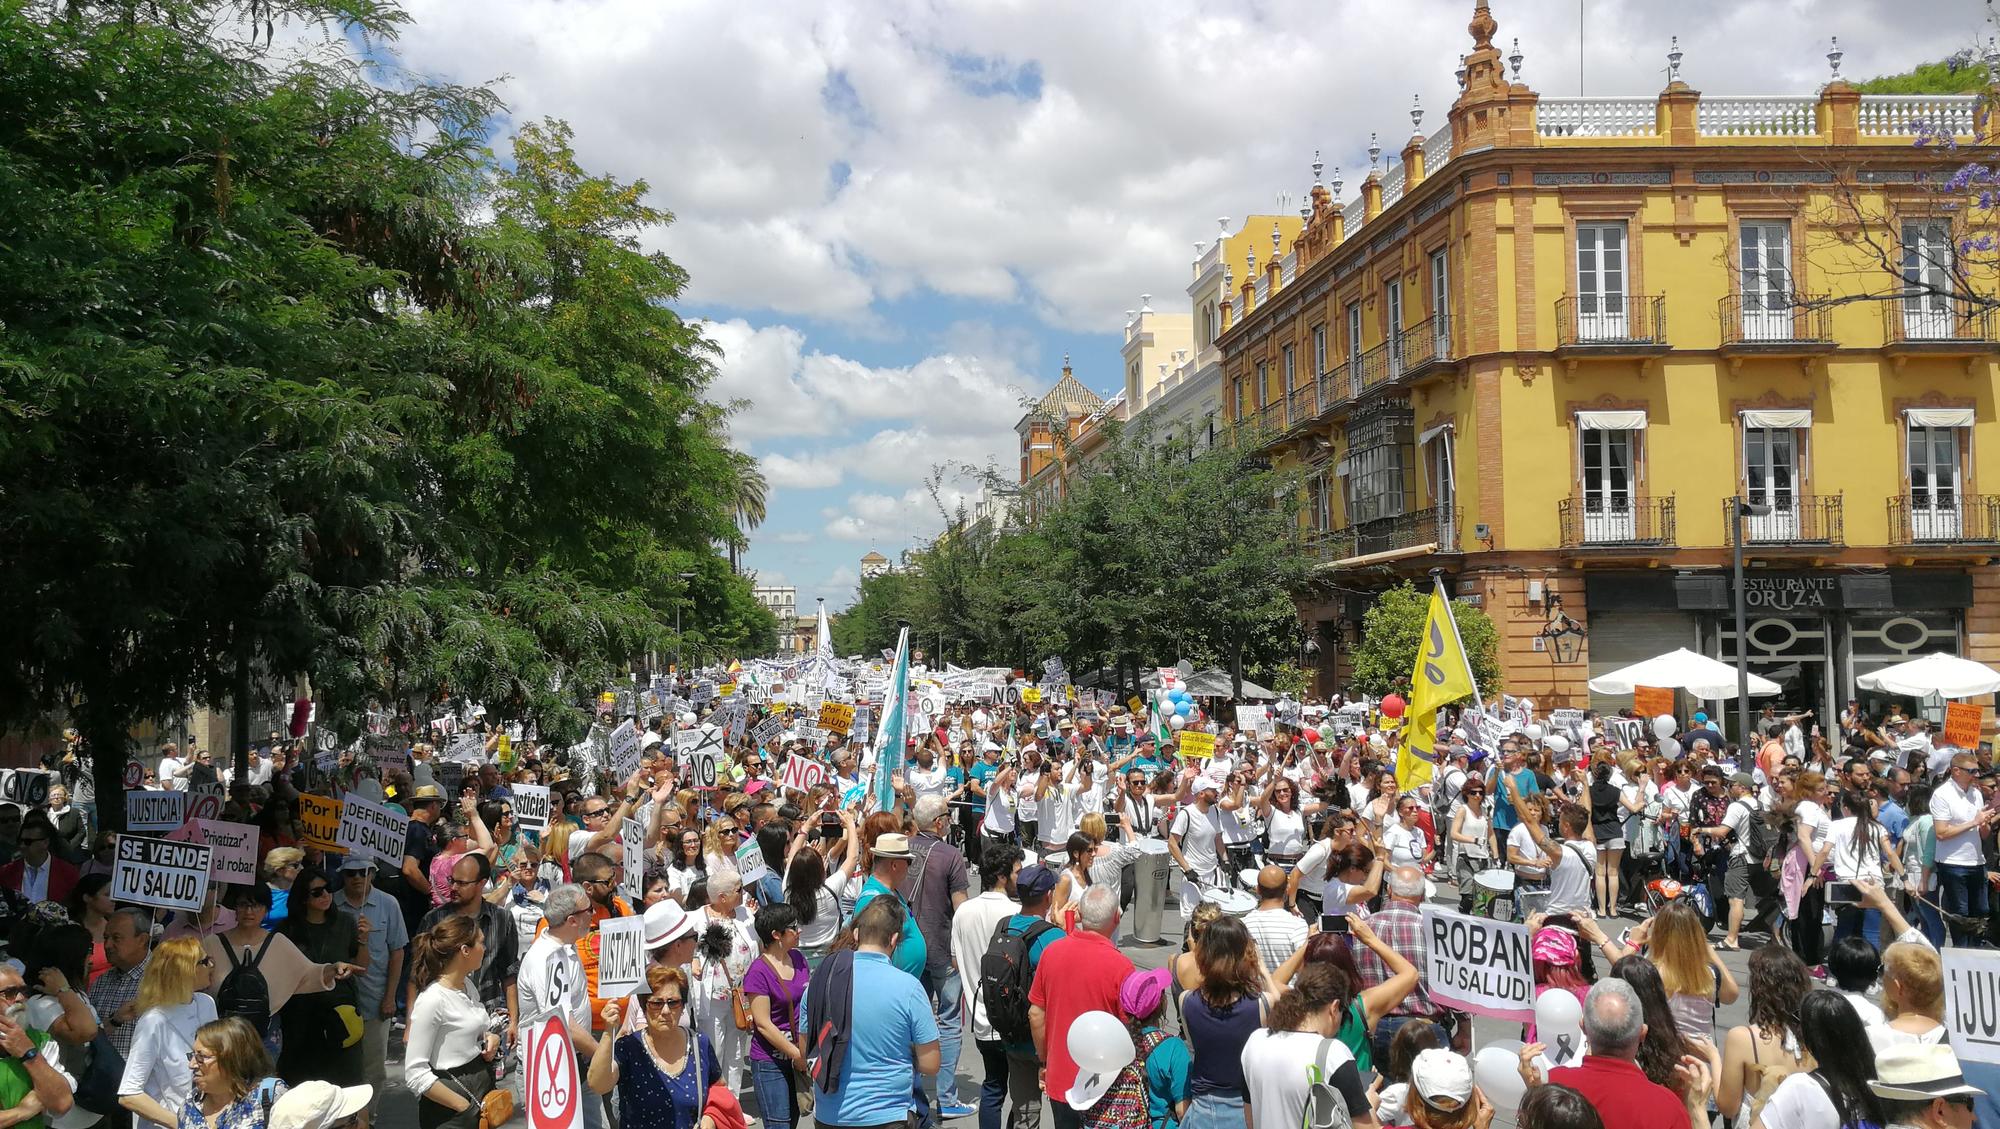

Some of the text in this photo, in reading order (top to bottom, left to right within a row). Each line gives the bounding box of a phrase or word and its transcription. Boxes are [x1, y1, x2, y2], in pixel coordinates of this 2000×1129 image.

[1732, 577, 1835, 591] ESTAURANTE
[1746, 588, 1825, 611] ORIZA
[843, 706, 852, 718] la
[993, 686, 1018, 705] NO
[690, 754, 716, 787] NO
[784, 756, 821, 793] NO
[300, 798, 343, 820] ¡Por l
[344, 803, 407, 836] ¡DEFIENDE
[121, 839, 210, 870] SE VENDE
[342, 820, 404, 861] TU SALUD!
[216, 856, 255, 874] al robar.
[122, 866, 199, 902] TU SALUD.
[1431, 917, 1531, 976] ROBAN
[1434, 958, 1532, 1005] TU SALUD!
[1950, 968, 2000, 1038] ¡JU
